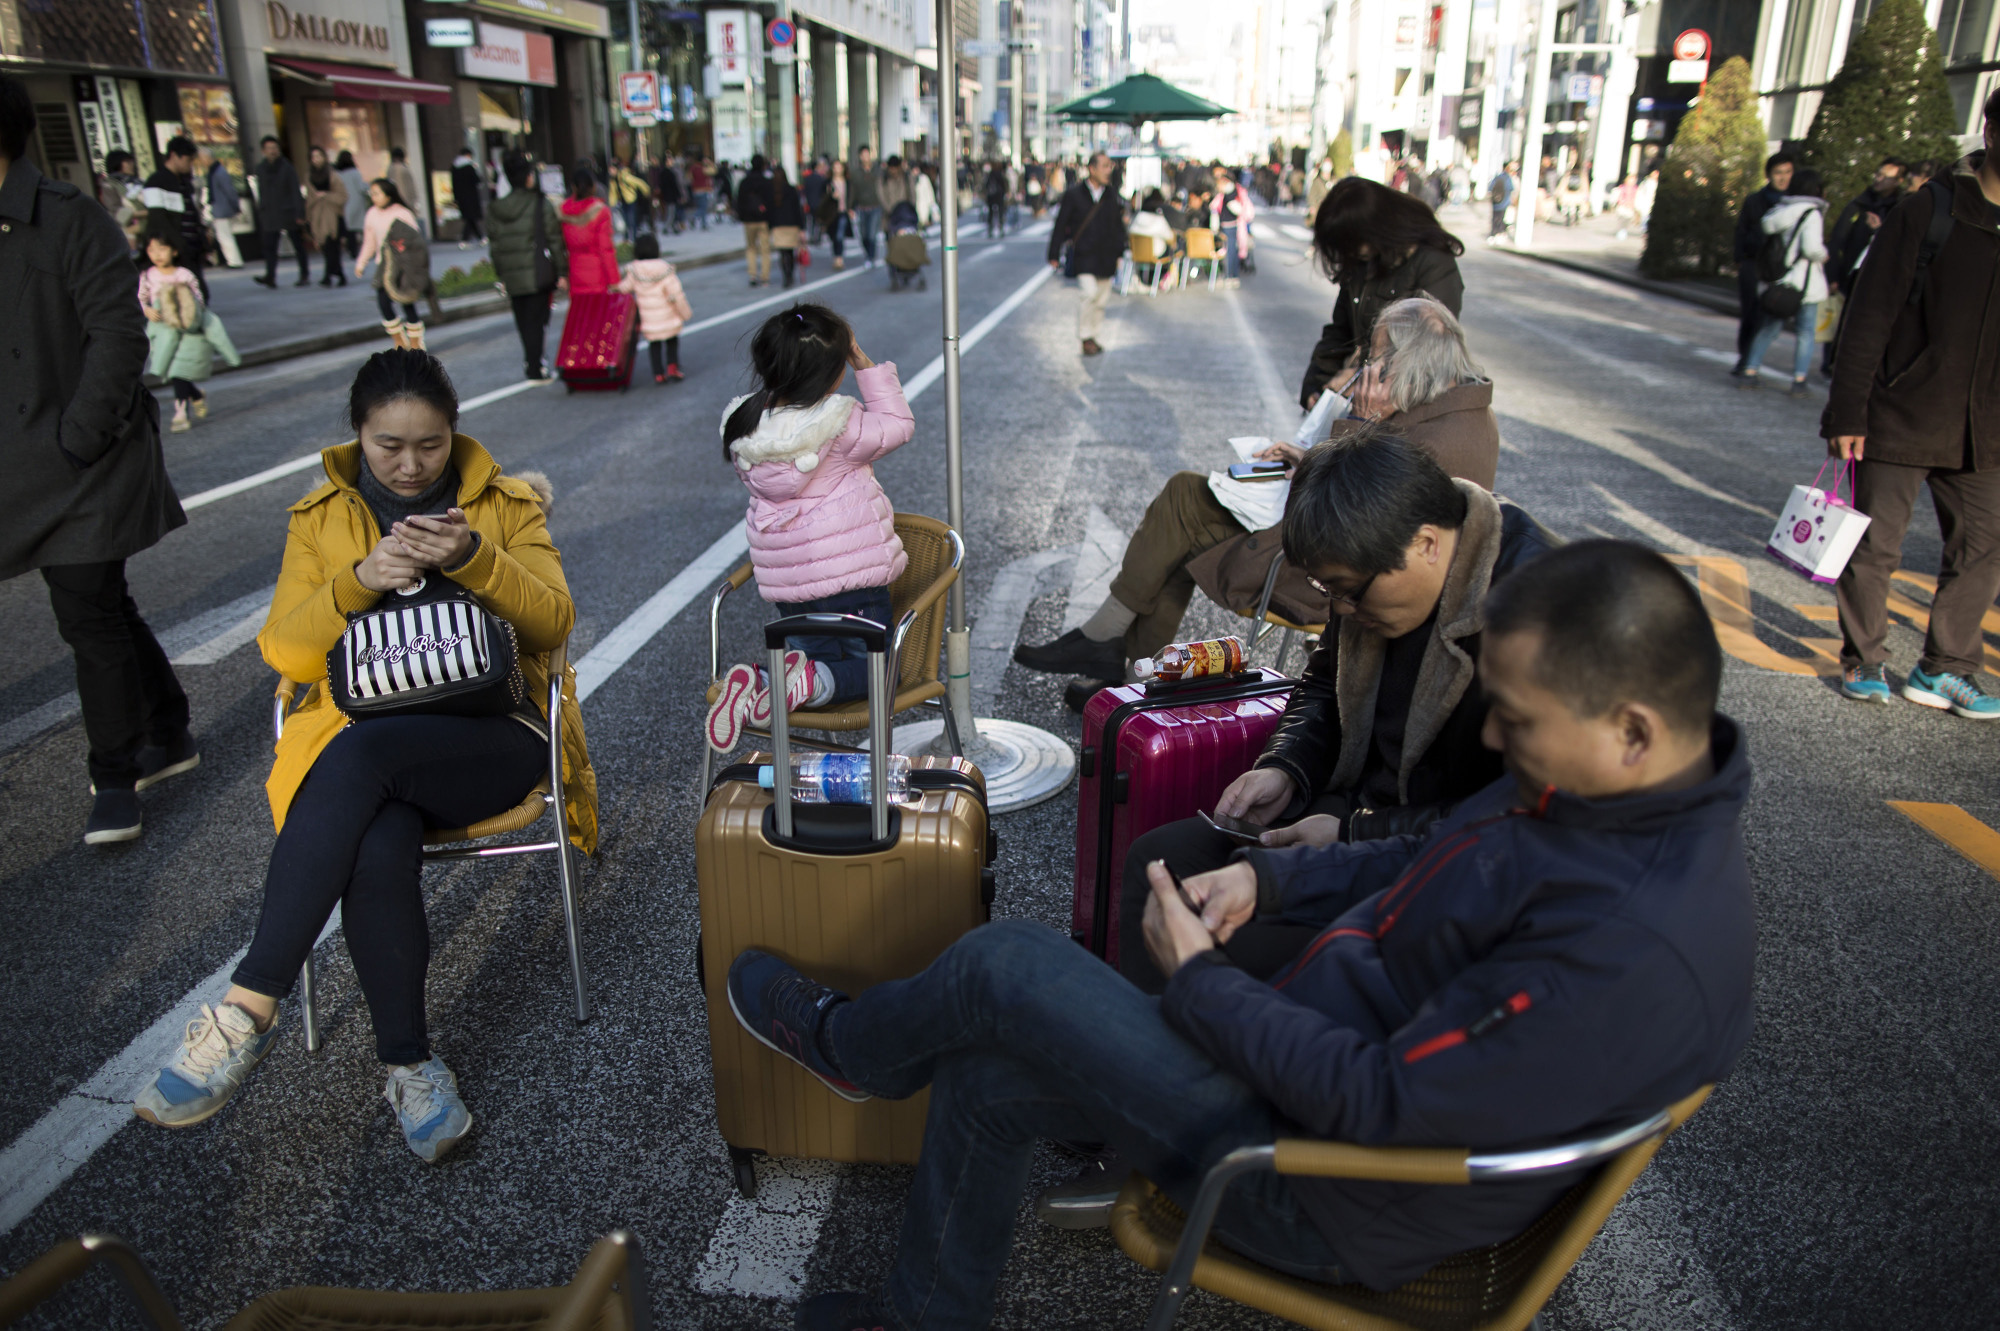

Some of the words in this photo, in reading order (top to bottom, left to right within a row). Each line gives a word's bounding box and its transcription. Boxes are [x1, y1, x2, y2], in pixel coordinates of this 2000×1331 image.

[266, 1, 390, 51] DALLOYAU
[357, 644, 410, 666] Betty
[410, 633, 463, 654] Boop
